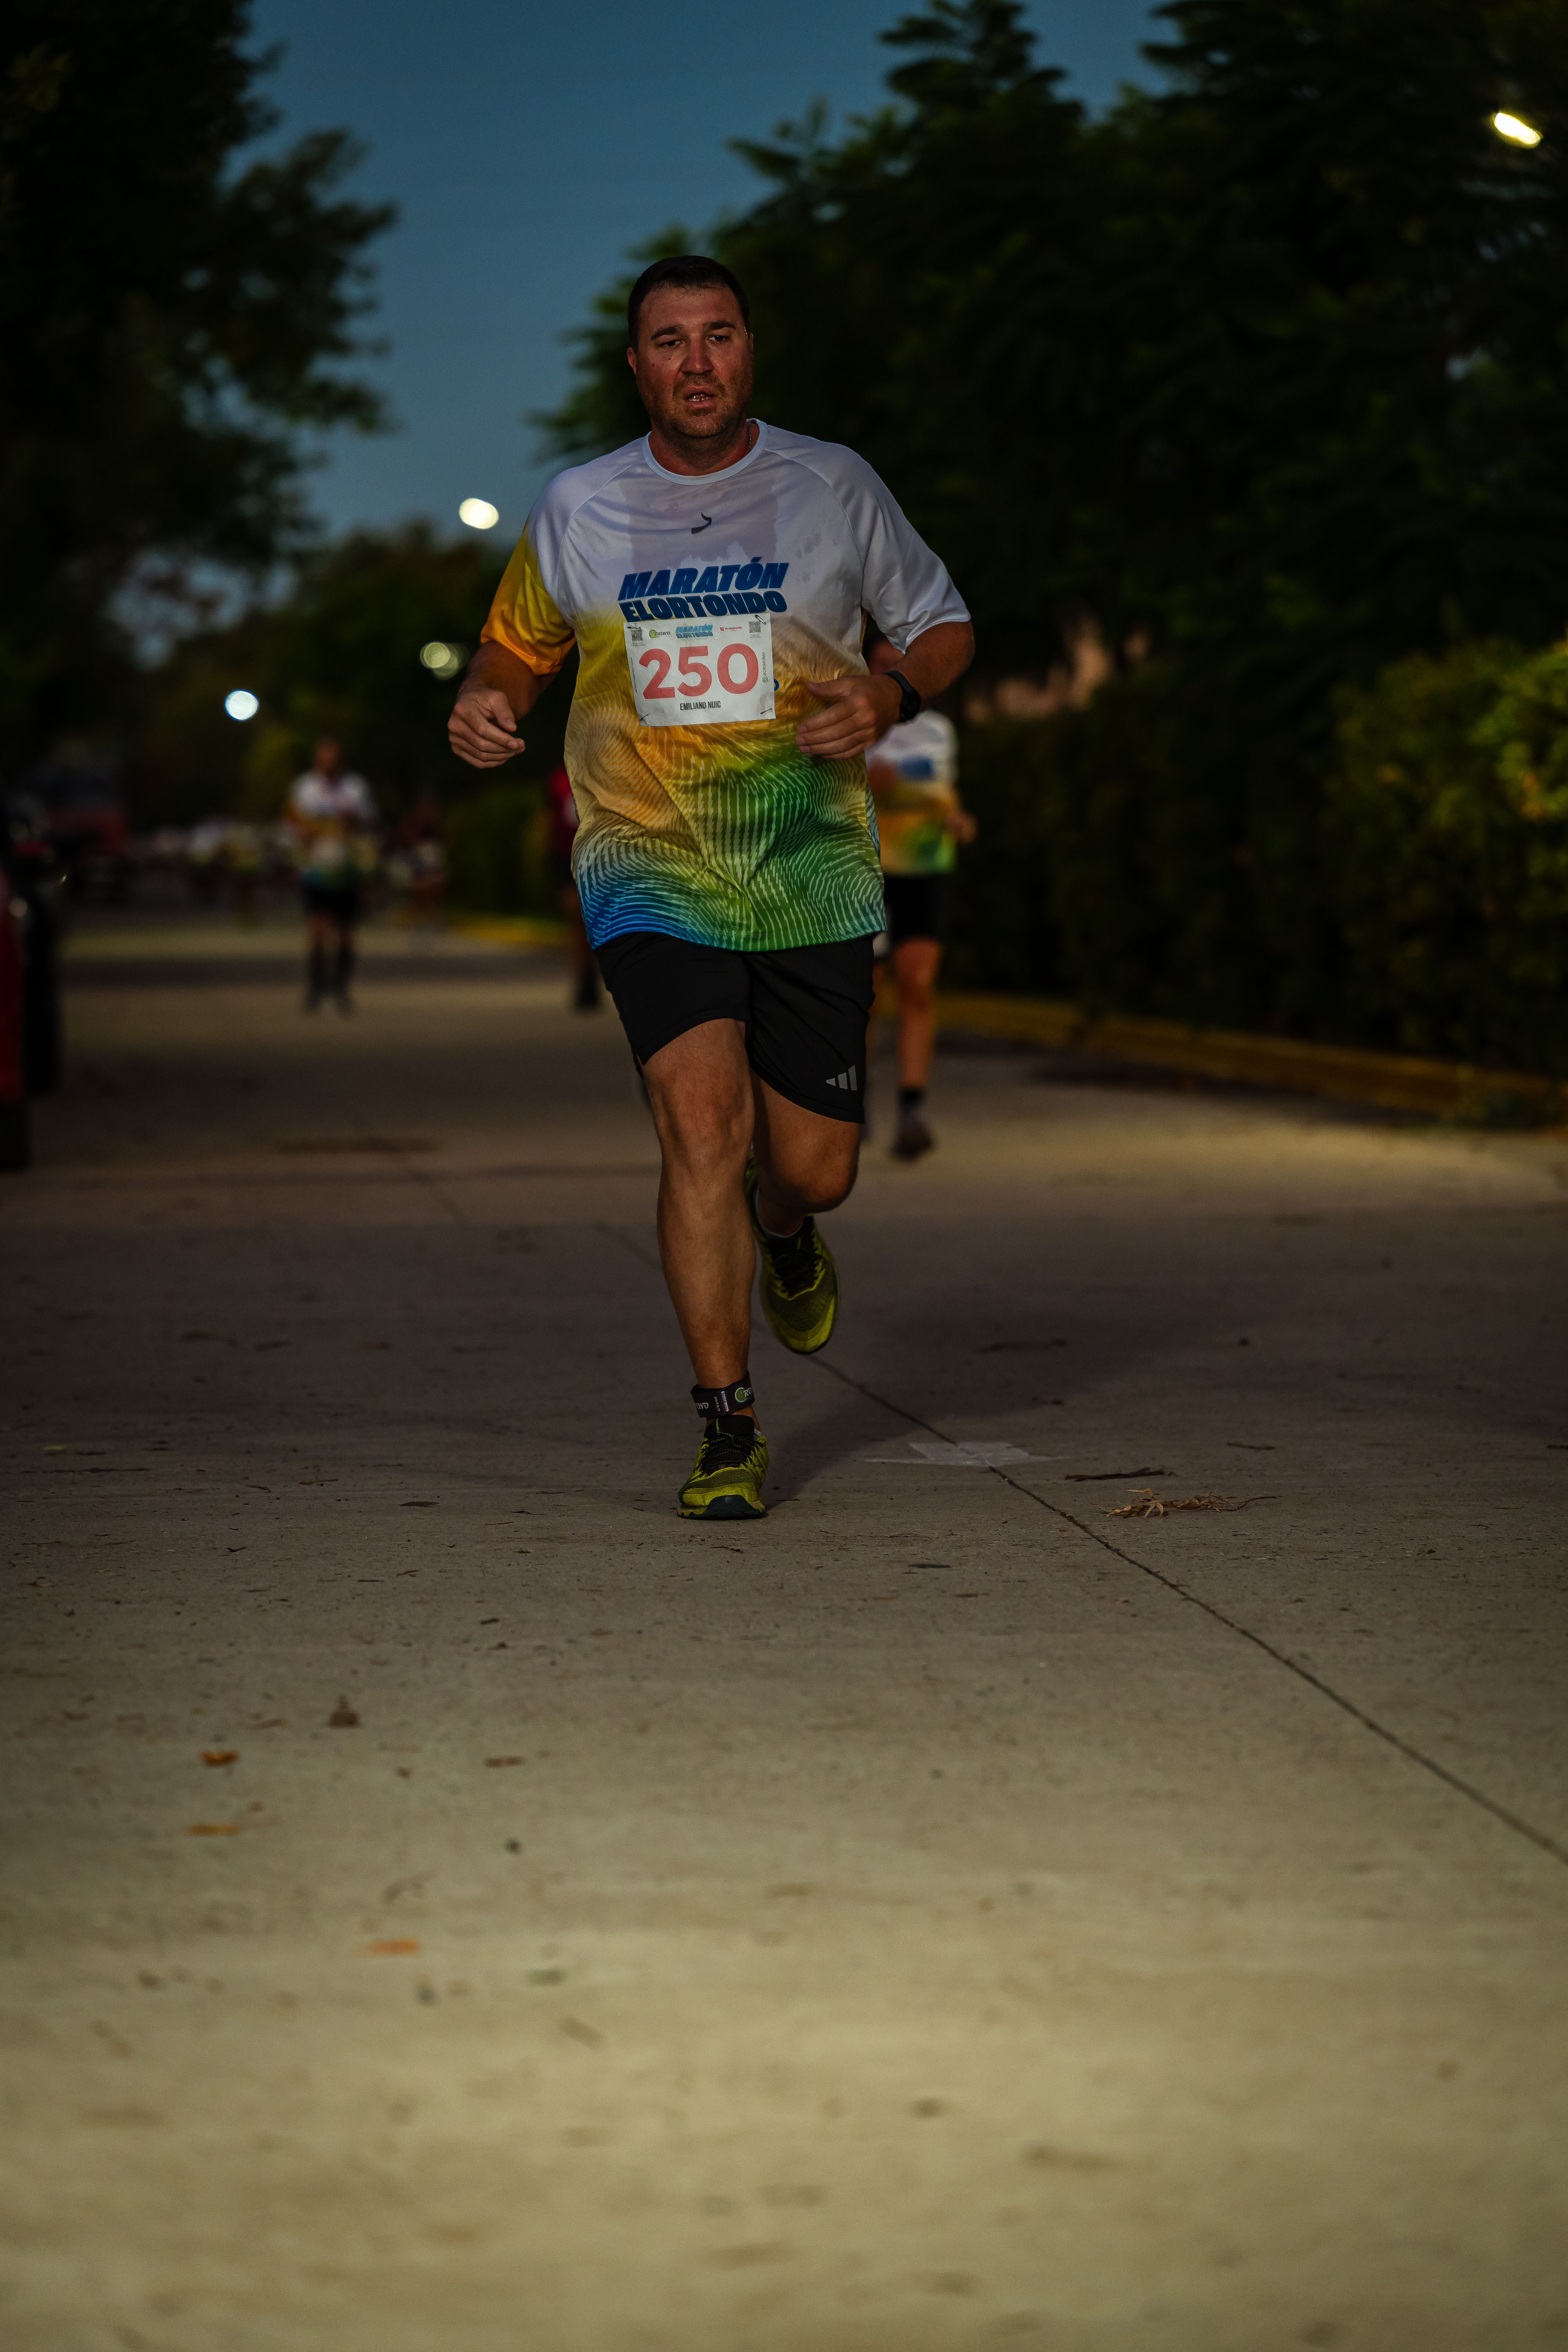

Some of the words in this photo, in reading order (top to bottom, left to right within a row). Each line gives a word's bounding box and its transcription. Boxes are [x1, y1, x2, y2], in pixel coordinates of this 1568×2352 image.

[618, 557, 789, 601] MARATÓN
[619, 591, 787, 622] ELORTONDO
[639, 643, 759, 699] 250
[680, 702, 706, 710] EMILIANO
